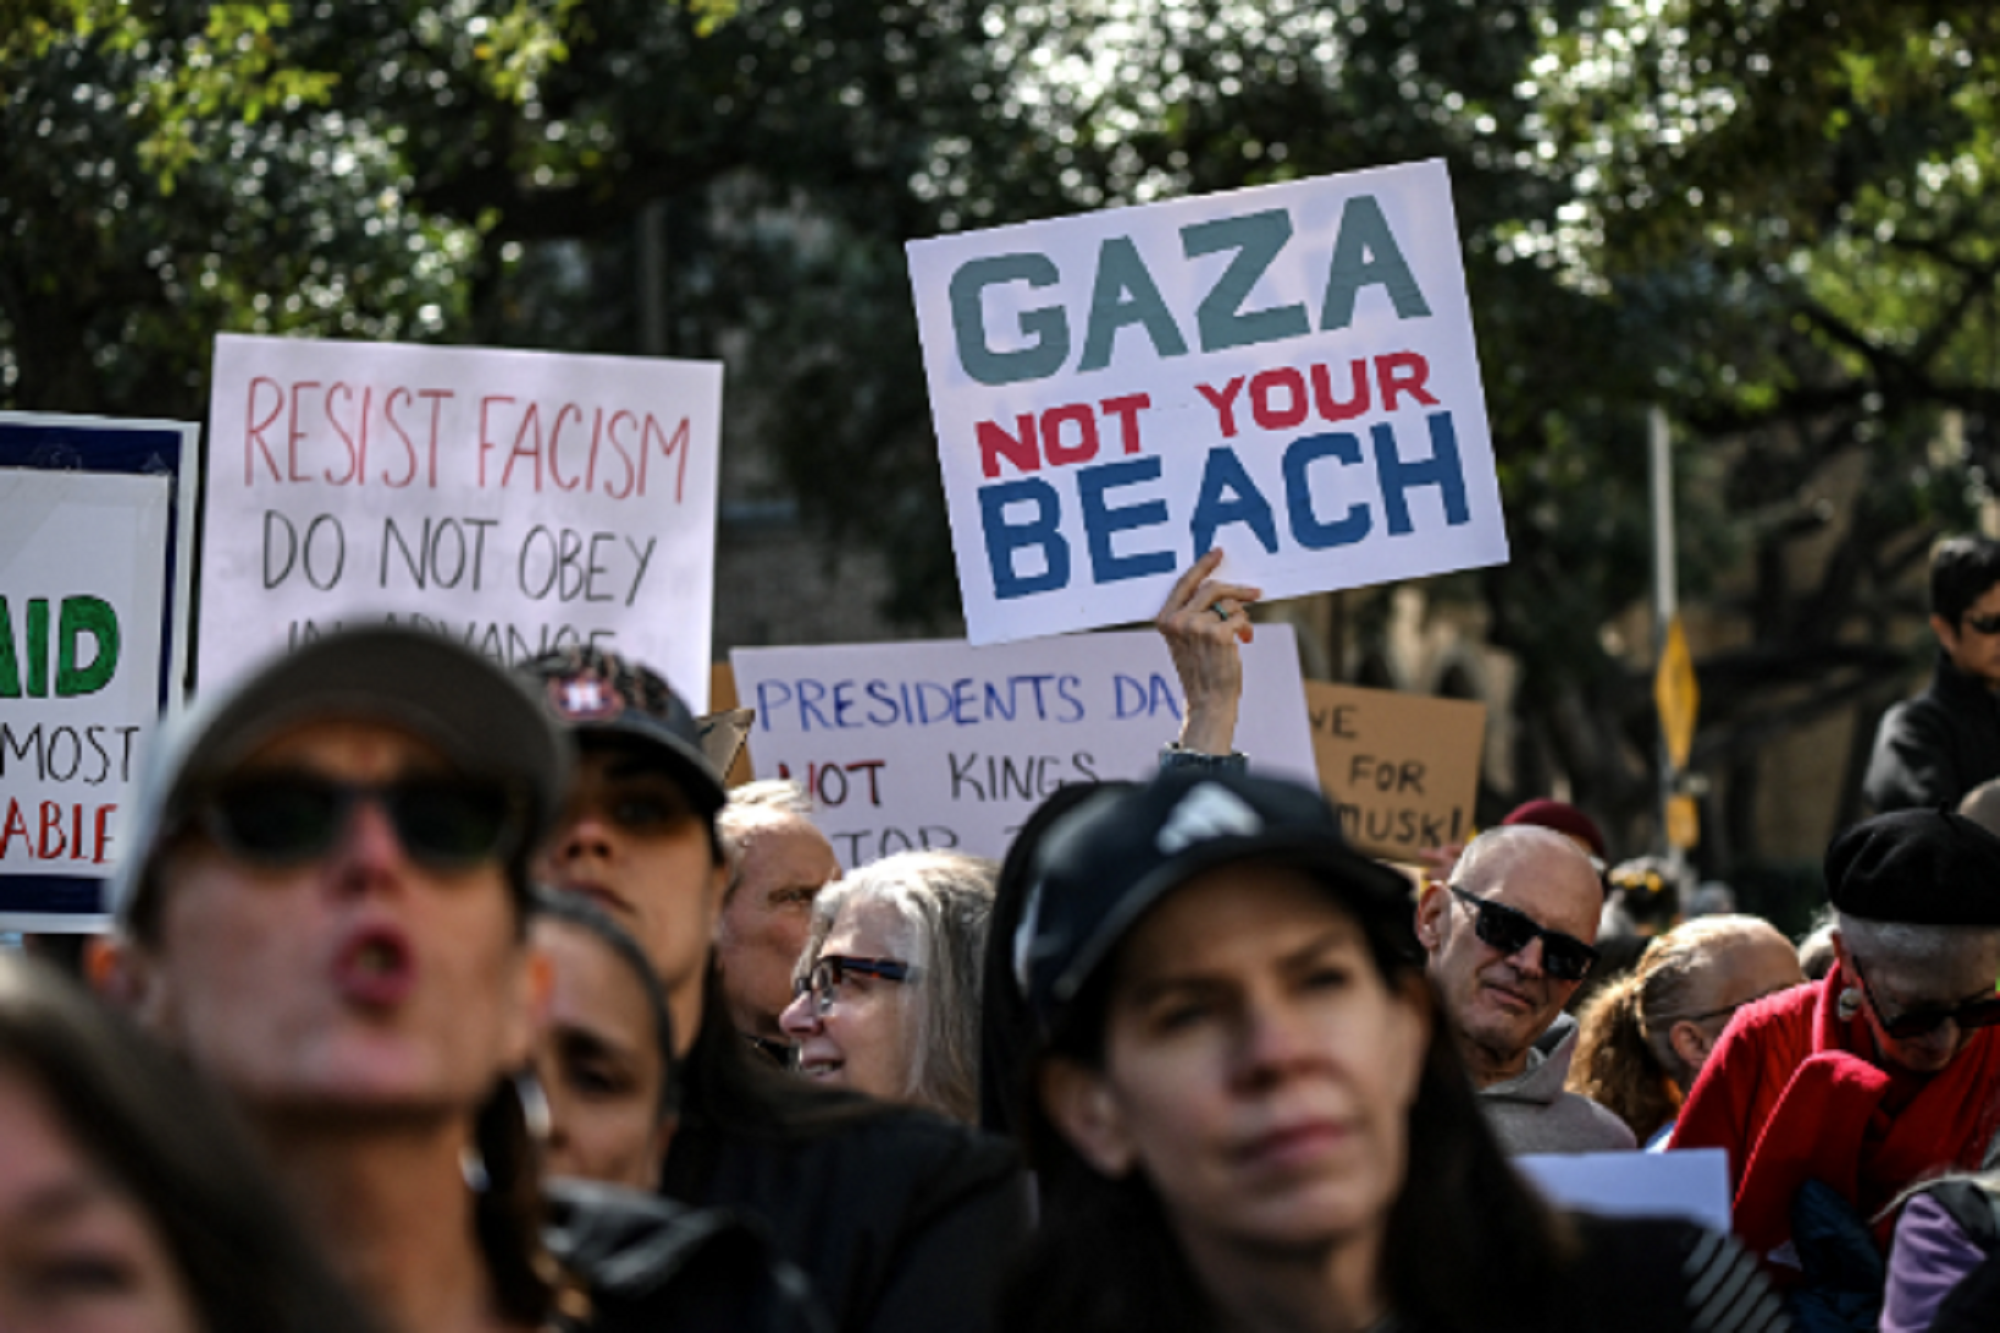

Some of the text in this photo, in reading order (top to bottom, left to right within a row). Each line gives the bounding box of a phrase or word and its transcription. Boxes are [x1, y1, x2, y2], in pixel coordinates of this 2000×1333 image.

[948, 194, 1433, 386] GAZA
[244, 376, 690, 503] RESIST FACISM
[974, 350, 1441, 477] NOT YOUR
[977, 410, 1471, 600] BEACH
[263, 509, 657, 607] DO NOT OBEY
[756, 671, 1184, 733] PRESIDENTS DA
[0, 722, 140, 786] MOST
[948, 752, 1101, 802] KINGS
[1349, 755, 1426, 794] FOR
[0, 796, 119, 865] ABLE
